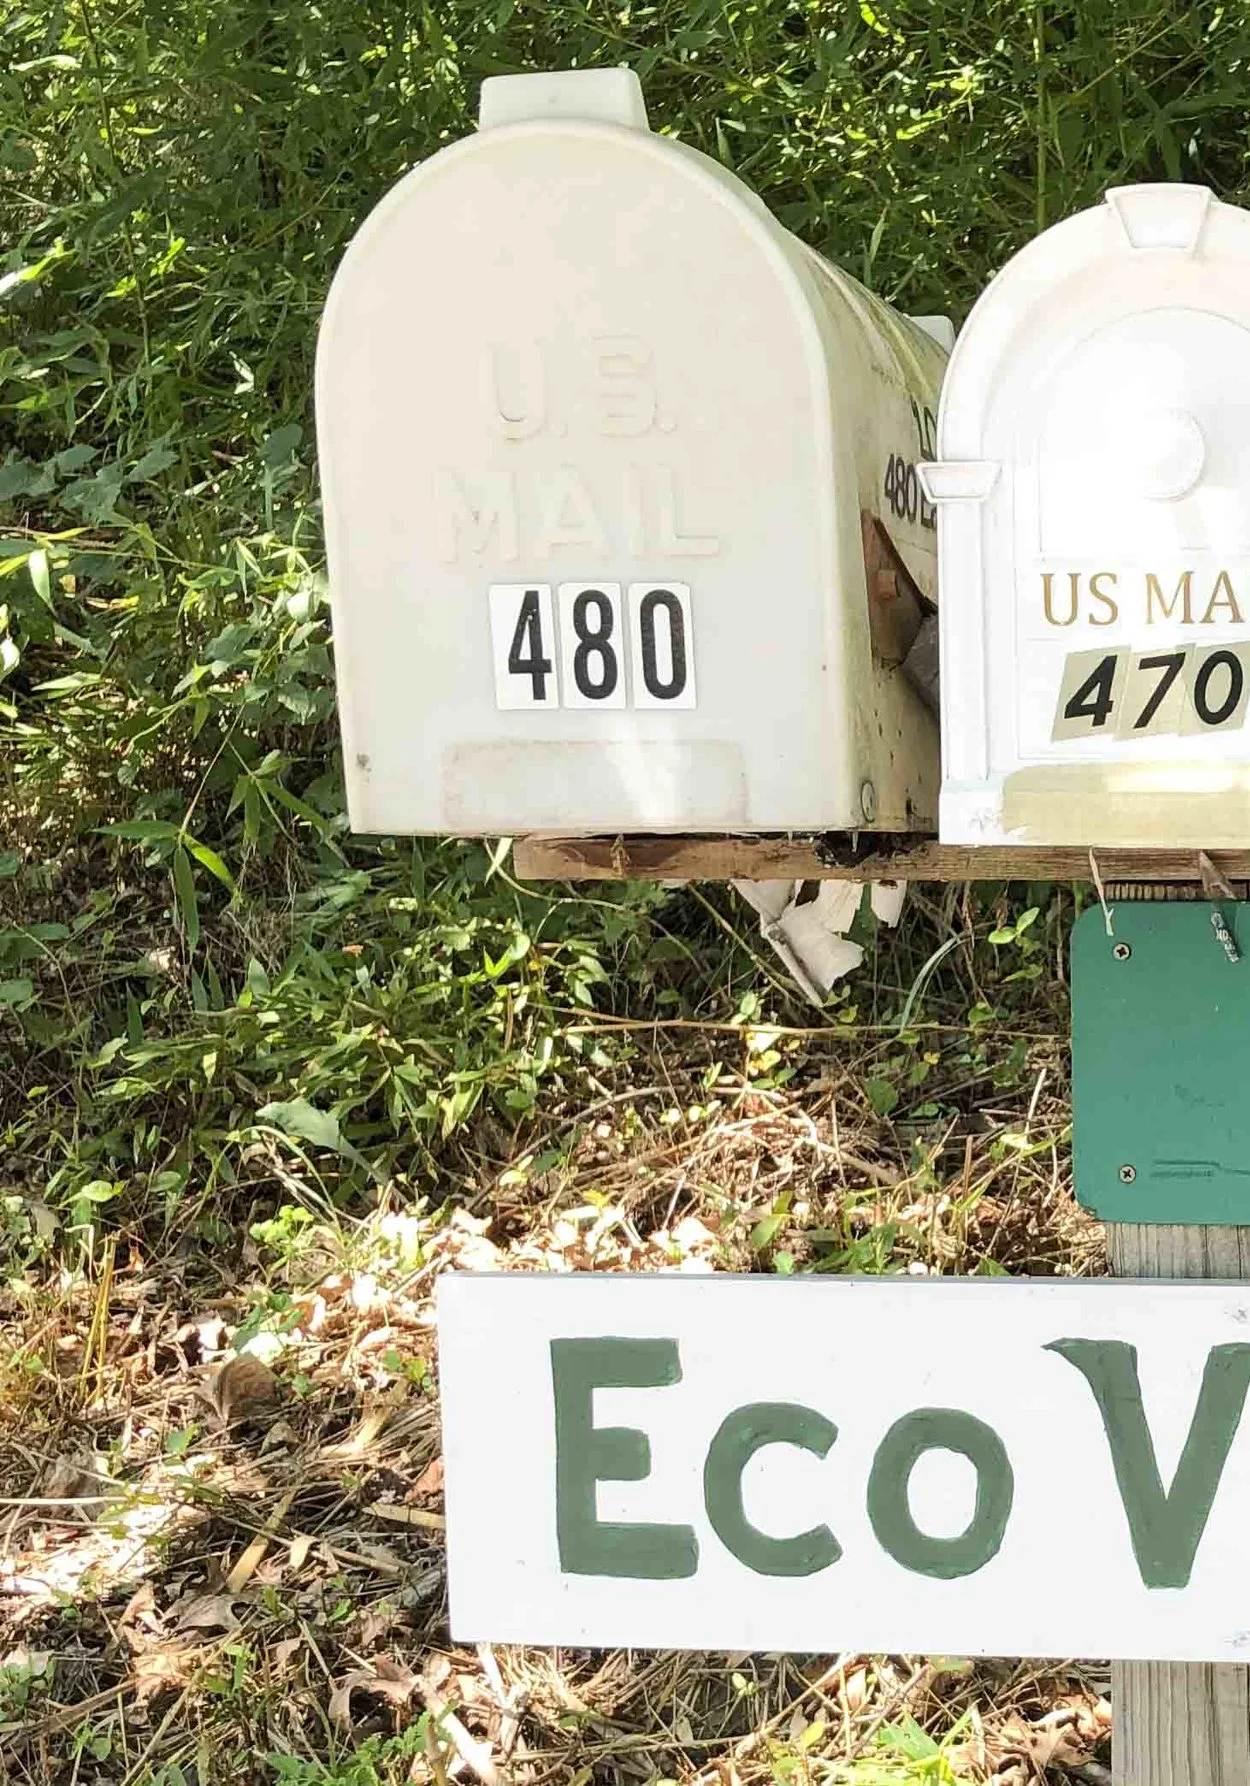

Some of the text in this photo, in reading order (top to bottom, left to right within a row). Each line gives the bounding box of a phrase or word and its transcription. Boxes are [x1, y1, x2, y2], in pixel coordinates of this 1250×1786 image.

[432, 462, 720, 565] MAIL
[884, 453, 917, 522] 480
[1041, 572, 1118, 625] US
[509, 590, 687, 700] 480
[1064, 650, 1244, 729] 470
[550, 1337, 1014, 1580] Eco
